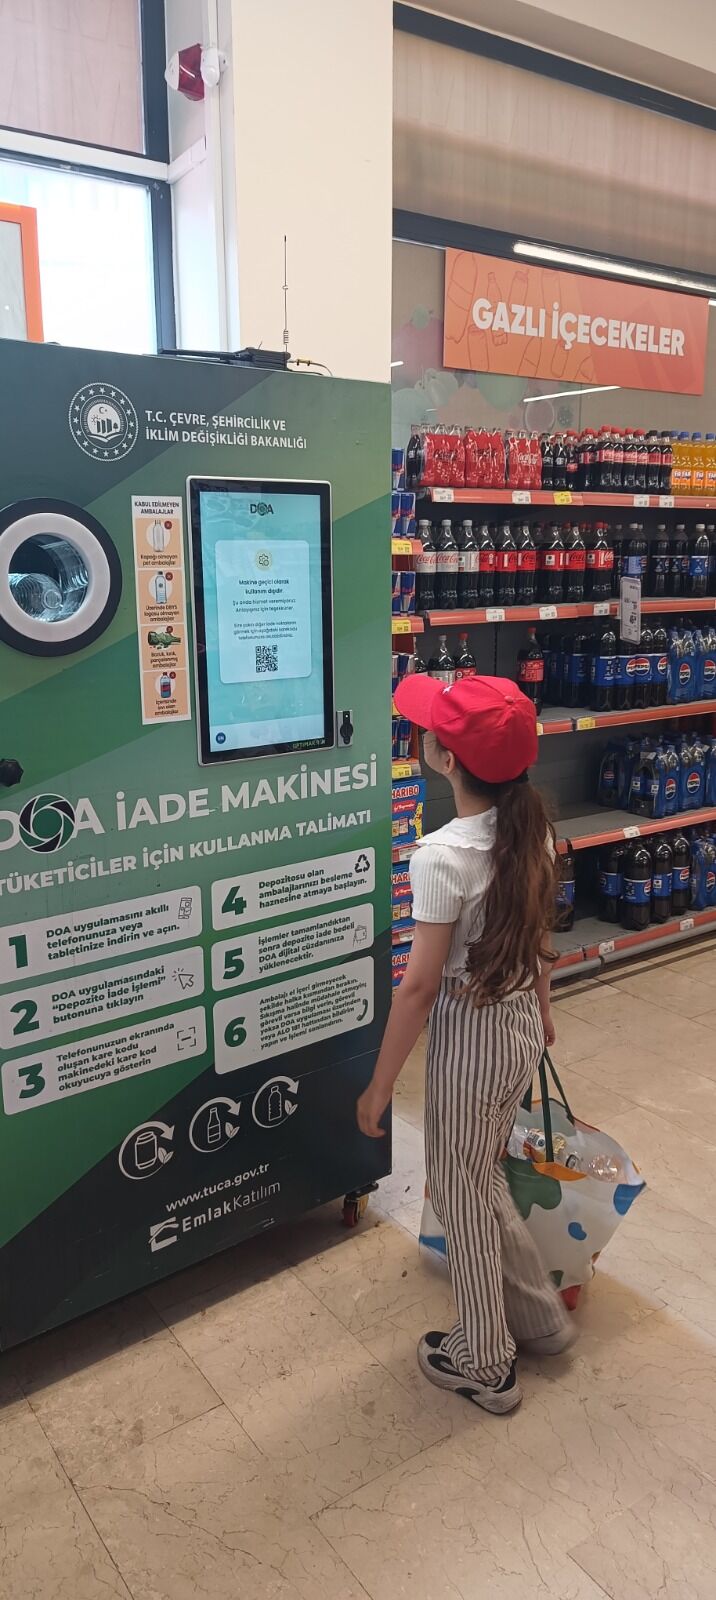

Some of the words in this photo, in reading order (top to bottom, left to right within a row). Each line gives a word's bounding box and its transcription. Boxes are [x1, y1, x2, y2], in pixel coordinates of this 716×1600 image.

[472, 298, 546, 337] GAZLI
[551, 302, 685, 356] İÇECEKELER
[145, 410, 166, 423] T.C.
[169, 412, 209, 427] ÇEVRE,
[212, 414, 270, 430] ŞEHİRCİLİK
[273, 420, 286, 431] VE
[145, 426, 179, 442] İKLİM
[182, 430, 248, 446] DEĞİŞİKLİĞİ
[250, 435, 307, 449] BAKANLIĞI
[250, 502, 274, 516] DOA
[116, 788, 209, 831] İADE
[221, 753, 376, 812] MAKİNESİ
[143, 843, 184, 870] İÇİN
[189, 825, 292, 859] KULLANMA
[296, 809, 370, 836] TALİMATI
[259, 873, 305, 889] Depozitosu
[307, 869, 324, 878] olan
[259, 879, 319, 899] ambalajlarınızı
[320, 872, 353, 884] besleme
[259, 893, 301, 908] haznesine
[303, 885, 332, 898] atmaya
[334, 878, 367, 891] başlayın.
[222, 886, 247, 915] 4
[46, 926, 71, 938] DOA
[74, 912, 143, 933] uygulamasını
[145, 904, 169, 916] akıllı
[47, 929, 117, 949] telefonunuza
[119, 922, 143, 933] veya
[258, 931, 289, 946] İşlemler
[291, 916, 351, 936] tamamlandıktan
[8, 934, 28, 968] 1
[48, 942, 104, 960] tabletinize
[107, 933, 140, 947] indirin
[142, 930, 154, 938] ve
[157, 925, 180, 936] açın.
[259, 944, 281, 954] sonra
[282, 933, 315, 948] depozito
[316, 929, 332, 939] iade
[333, 922, 355, 934] bedeli
[259, 951, 277, 963] DOA
[278, 946, 300, 958] dijital
[301, 935, 344, 951] cüzdanınıza
[223, 947, 244, 979] 5
[52, 990, 76, 1002] DOA
[78, 965, 165, 996] uygulamasındaki
[10, 1000, 40, 1035] 2
[53, 1005, 104, 1024] butonuna
[106, 993, 144, 1010] tıklayın
[56, 1037, 127, 1062] Telefonunuzun
[129, 1023, 174, 1041] ekranında
[224, 1017, 247, 1047] 6
[57, 1057, 90, 1072] oluşan
[92, 1051, 113, 1062] kare
[115, 1043, 138, 1055] kodu
[58, 1060, 114, 1082] makinedeki
[117, 1052, 137, 1064] kare
[139, 1046, 157, 1057] kod
[18, 1062, 45, 1098] 3
[59, 1072, 111, 1091] okuyucuya
[114, 1058, 151, 1076] gösterin
[166, 1163, 270, 1212] www.tuca.gov.tr
